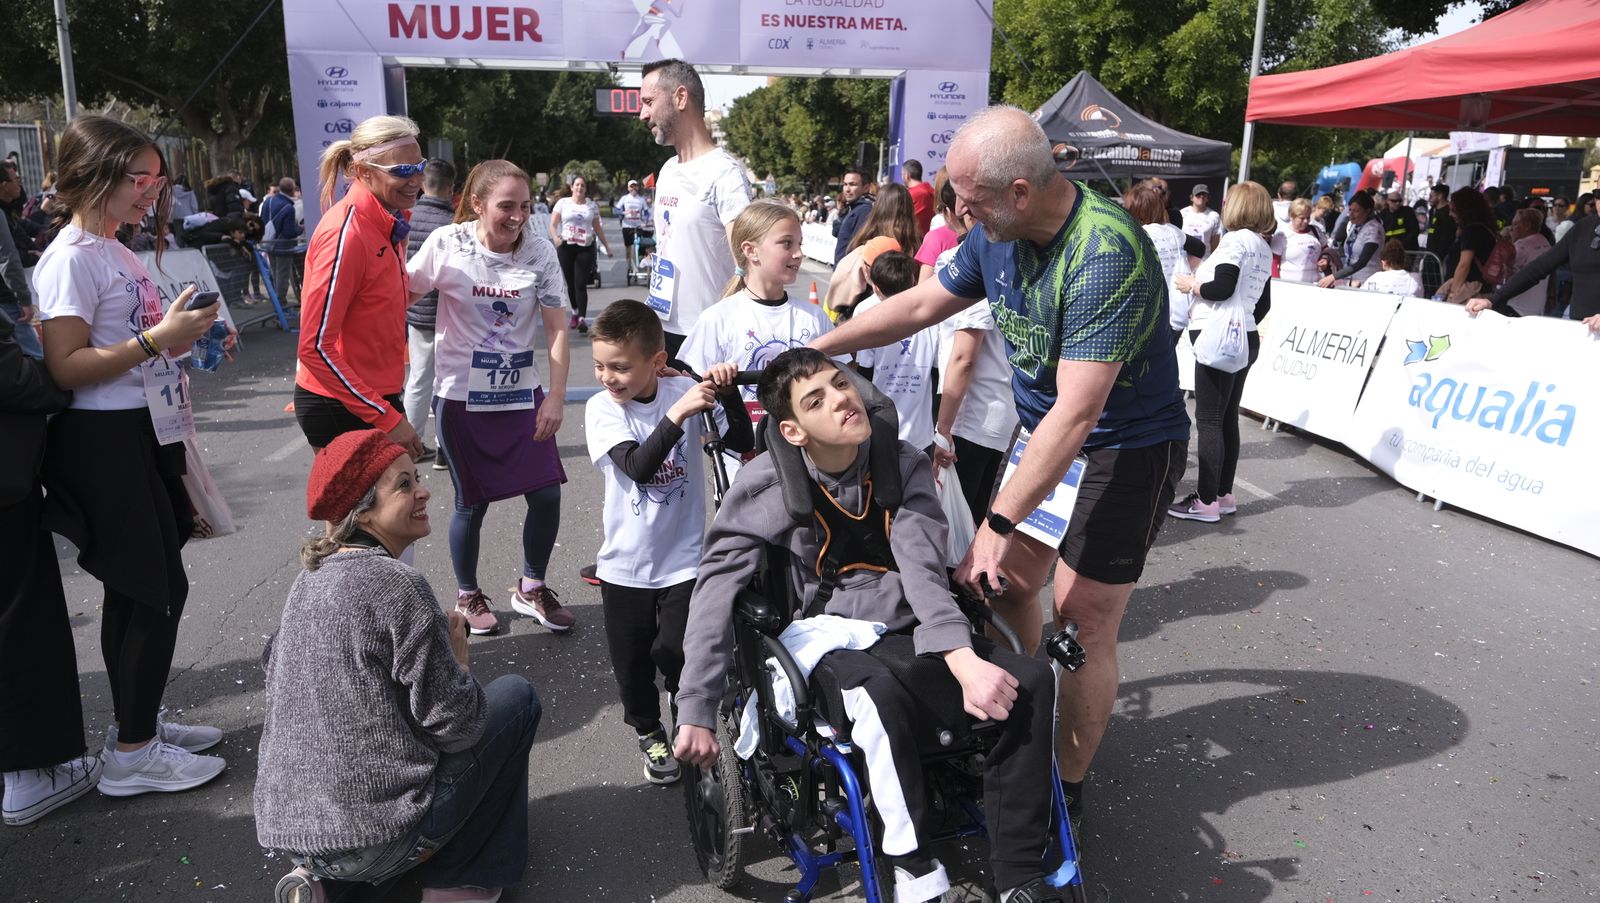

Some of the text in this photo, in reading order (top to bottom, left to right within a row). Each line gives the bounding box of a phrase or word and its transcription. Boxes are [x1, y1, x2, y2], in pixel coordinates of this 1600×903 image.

[388, 3, 543, 42] MUJER
[761, 14, 907, 31] ES NUESTRA META.
[768, 37, 791, 50] CDX
[660, 196, 679, 208] MUJER
[472, 285, 521, 299] MUJER
[1279, 326, 1368, 368] ALMERÍA
[487, 369, 520, 386] 170
[1272, 354, 1318, 380] CIUDAD
[1408, 371, 1577, 448] aqualia
[1388, 431, 1402, 448] tu
[1465, 456, 1496, 478] del
[1497, 469, 1545, 495] agua
